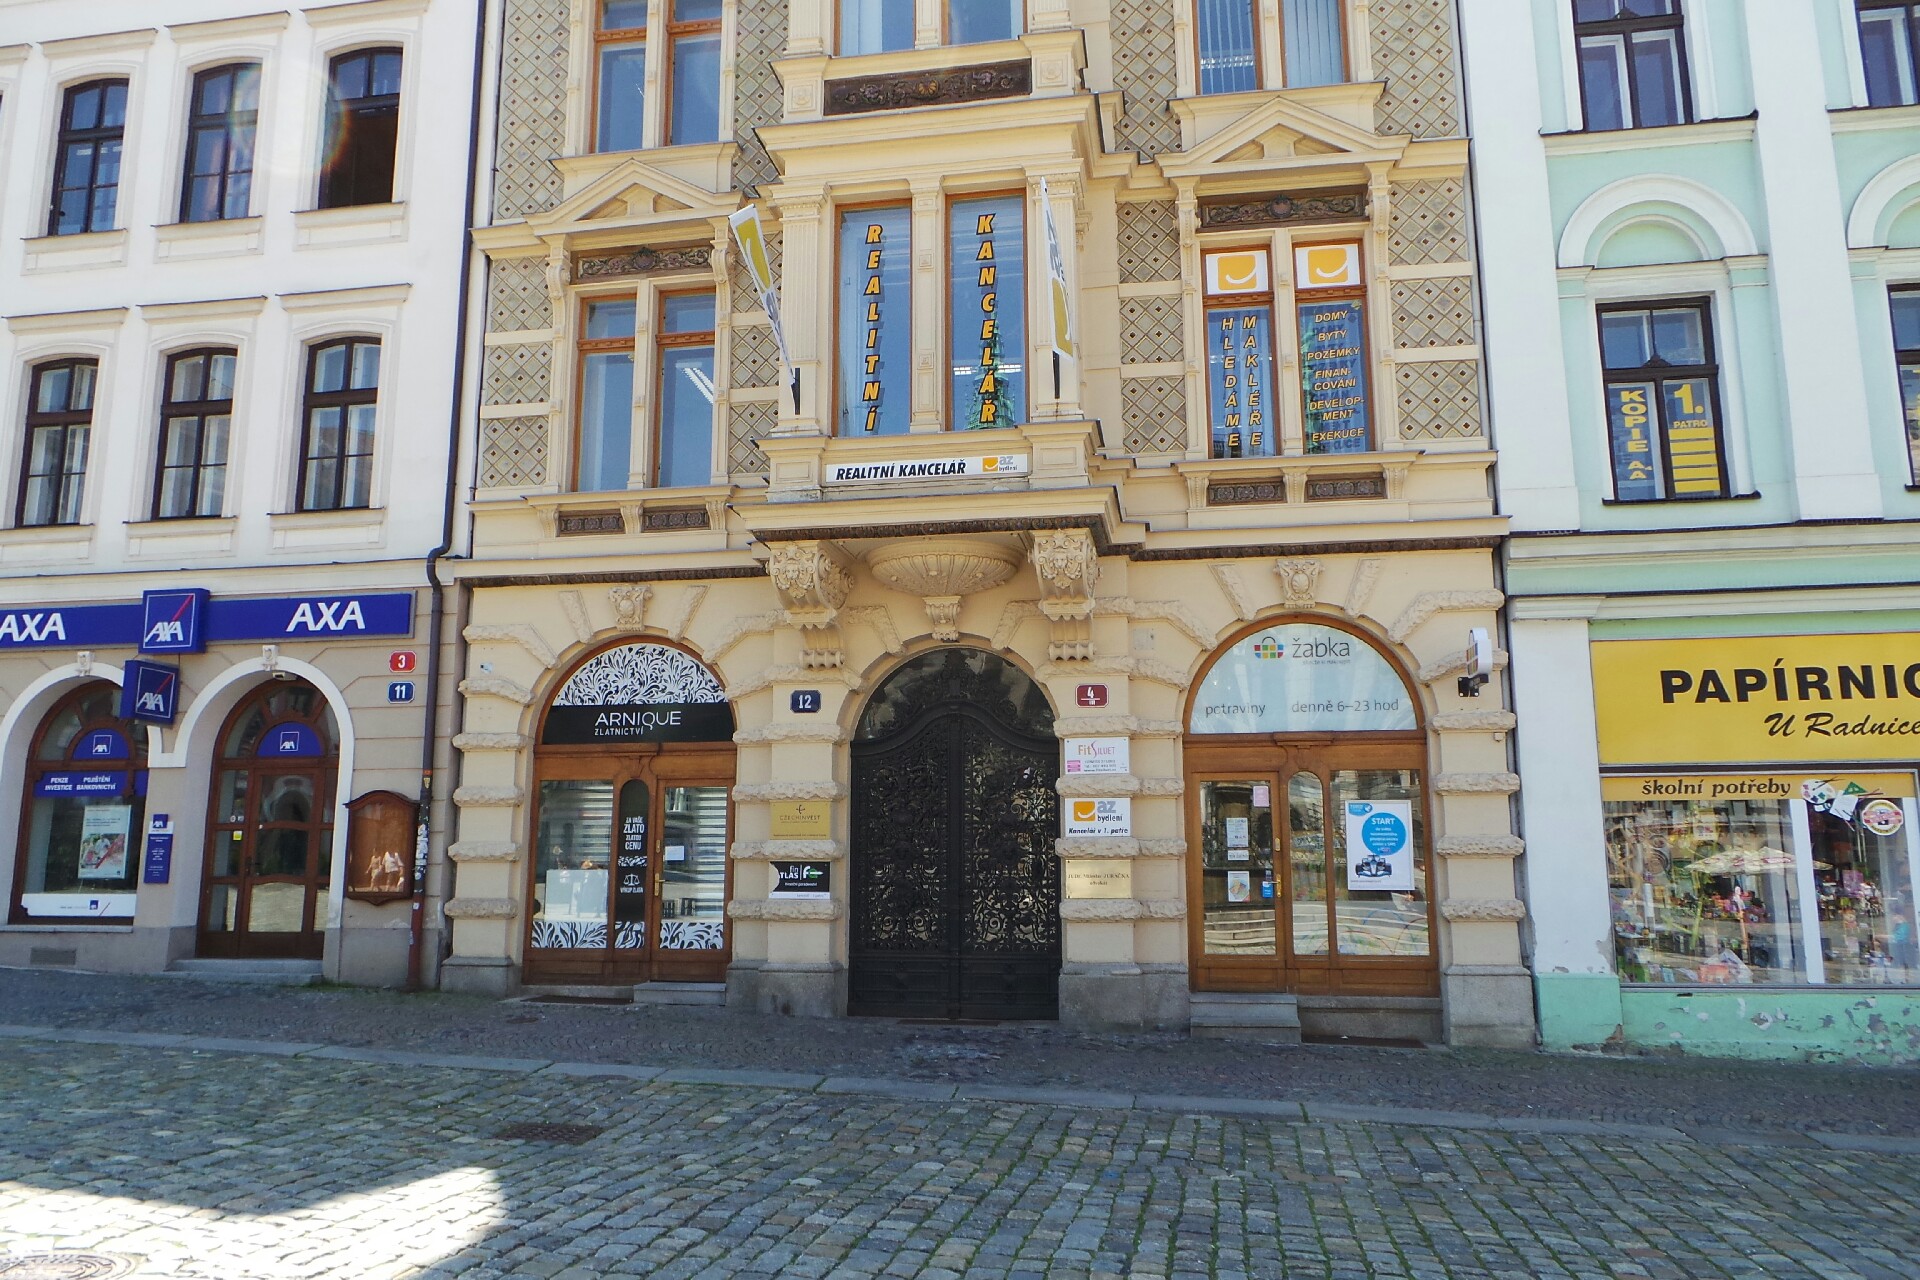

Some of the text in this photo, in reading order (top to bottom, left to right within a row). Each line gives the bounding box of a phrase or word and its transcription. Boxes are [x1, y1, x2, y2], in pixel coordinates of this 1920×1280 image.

[976, 213, 996, 423] KANCELÁŘ
[1315, 310, 1348, 323] DOMY
[862, 224, 883, 431] REALITNÍ
[1318, 330, 1347, 342] BYTY
[1306, 346, 1361, 361] POZEMKY
[1242, 316, 1262, 446] MAKLÉŘE
[1315, 368, 1352, 380] FINAN-
[1221, 317, 1240, 447] HLEDÁME
[1314, 377, 1356, 391] COVÁNÍ
[1309, 396, 1365, 411] DEVELOP-
[1674, 384, 1704, 414] 1.
[1322, 409, 1354, 421] MENT
[1621, 390, 1648, 453] KOPIE
[1673, 420, 1708, 429] PATRO
[1312, 427, 1365, 443] EXEKUCE
[999, 455, 1014, 465] az
[836, 459, 966, 480] REALITNÍ KANCELÁŘ
[286, 601, 365, 632] AXA
[0, 612, 66, 642] AXA
[144, 621, 184, 643] AXA
[1292, 637, 1350, 658] žabka
[397, 655, 406, 668] 3
[394, 685, 406, 699] 11
[1087, 686, 1095, 699] 4
[136, 692, 164, 712] AXA
[798, 695, 812, 709] 12
[1291, 700, 1333, 713] denně
[1375, 699, 1399, 712] hod
[1205, 703, 1266, 718] potraviny
[594, 711, 682, 730] ARNIQUE
[1764, 711, 1920, 738] U Radnice
[594, 726, 644, 736] ZLATNICTVÍ
[93, 744, 107, 752] AXA
[280, 741, 295, 749] AXA
[1642, 778, 1791, 799] školní potřeby
[1097, 801, 1116, 813] az
[1097, 814, 1122, 823] bydlení
[623, 824, 645, 833] ZLATO
[625, 841, 642, 850] CENU
